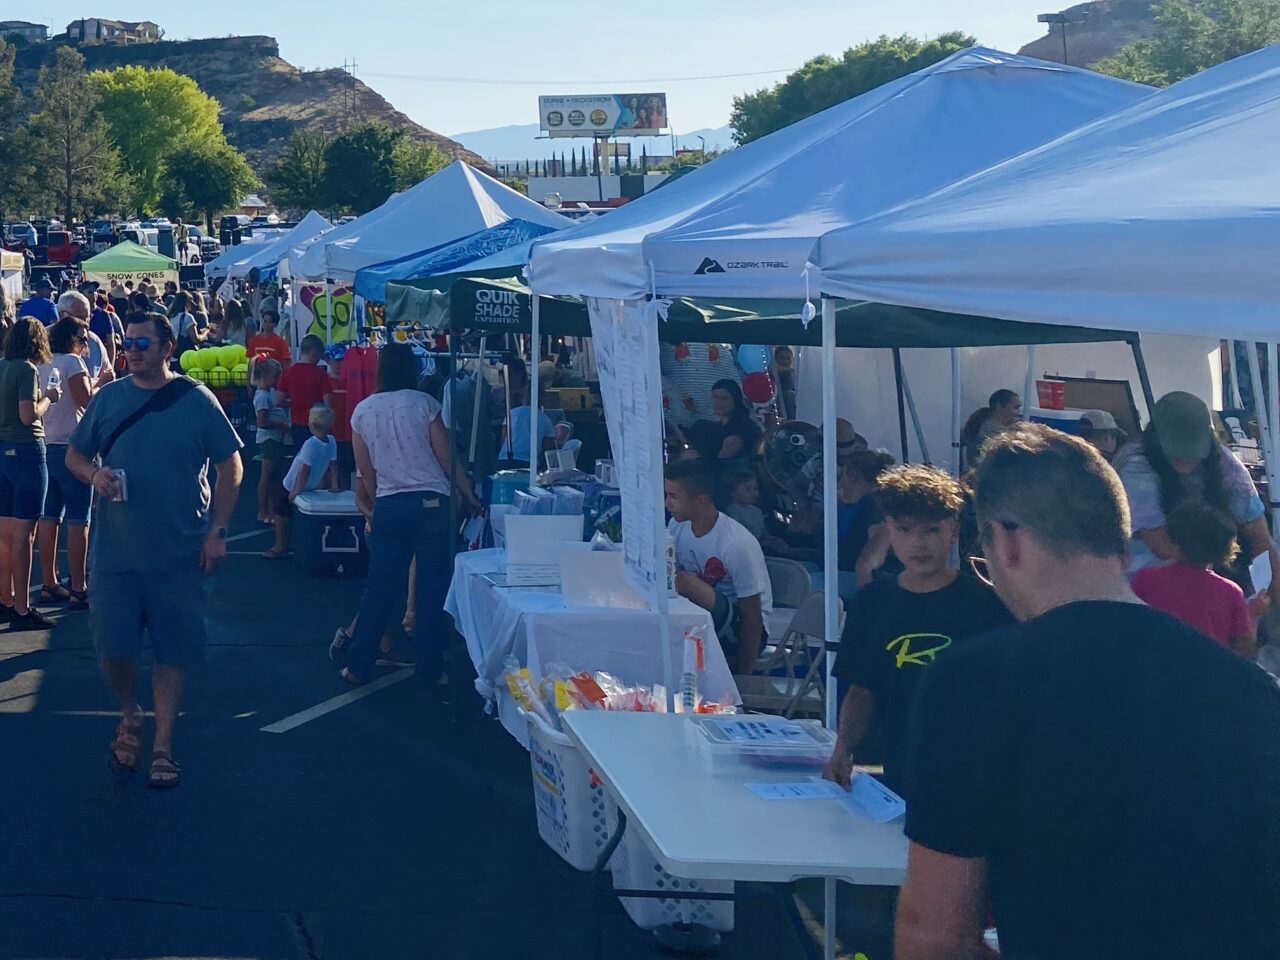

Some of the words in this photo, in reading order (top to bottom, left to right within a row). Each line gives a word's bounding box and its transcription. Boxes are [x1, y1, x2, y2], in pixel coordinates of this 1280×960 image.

[136, 271, 165, 279] CONES
[476, 289, 520, 305] QUIK
[475, 303, 520, 318] SHADE
